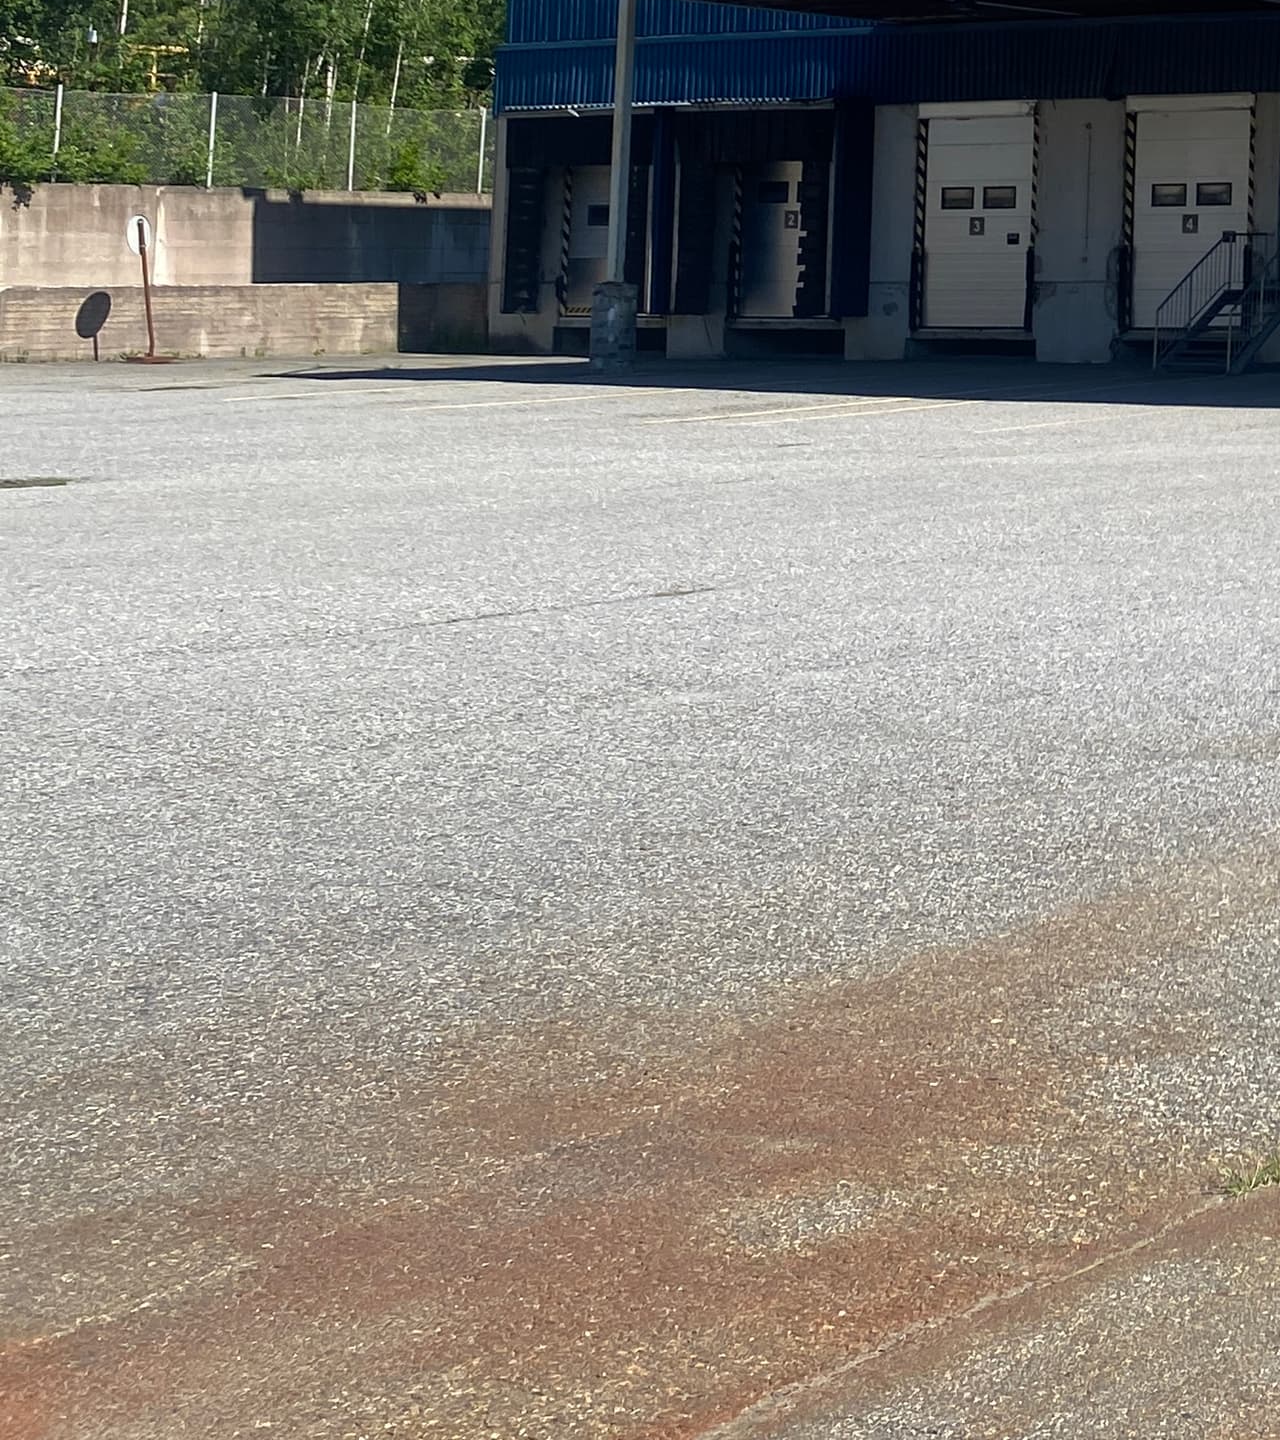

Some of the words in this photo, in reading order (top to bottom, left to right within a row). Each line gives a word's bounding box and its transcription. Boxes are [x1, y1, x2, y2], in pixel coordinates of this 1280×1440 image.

[787, 214, 795, 227] 2
[974, 220, 981, 232] 3
[1186, 218, 1193, 231] 4
